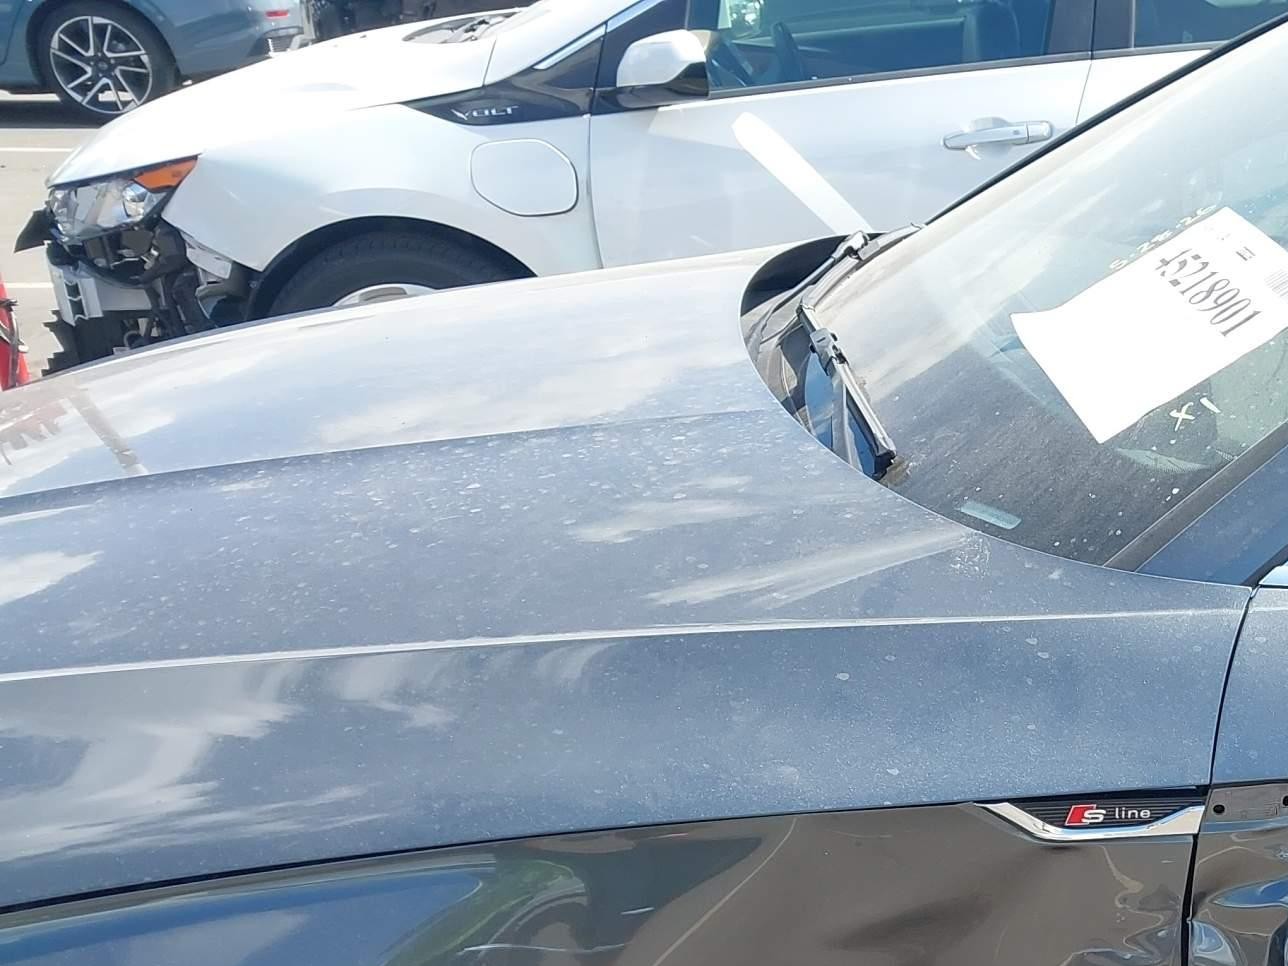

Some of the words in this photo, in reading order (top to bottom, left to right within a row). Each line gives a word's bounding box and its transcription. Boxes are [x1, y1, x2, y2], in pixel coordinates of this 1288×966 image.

[450, 105, 519, 121] VOLT
[1154, 248, 1262, 337] 45218901
[1115, 807, 1151, 819] line
